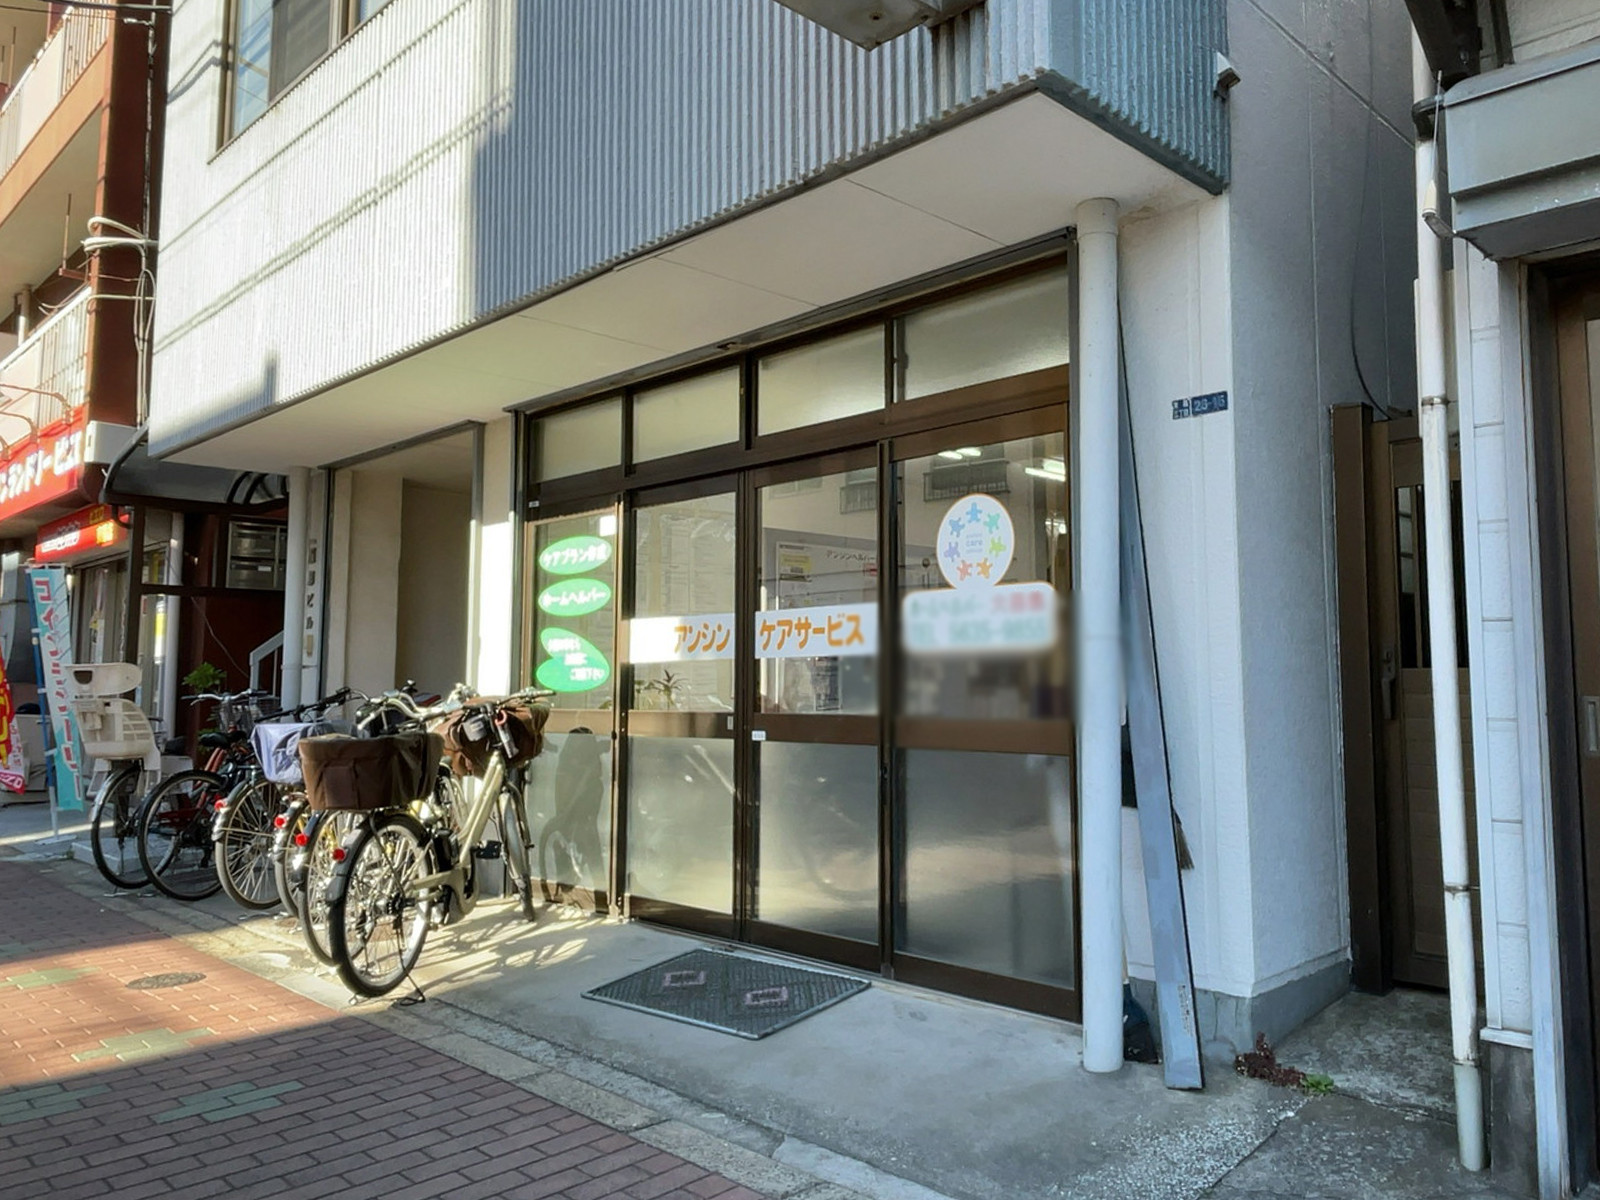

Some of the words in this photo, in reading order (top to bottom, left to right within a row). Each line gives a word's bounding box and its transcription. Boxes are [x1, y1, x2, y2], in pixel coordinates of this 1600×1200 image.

[674, 621, 731, 654] アンシン
[759, 613, 865, 652] ケアサービス
